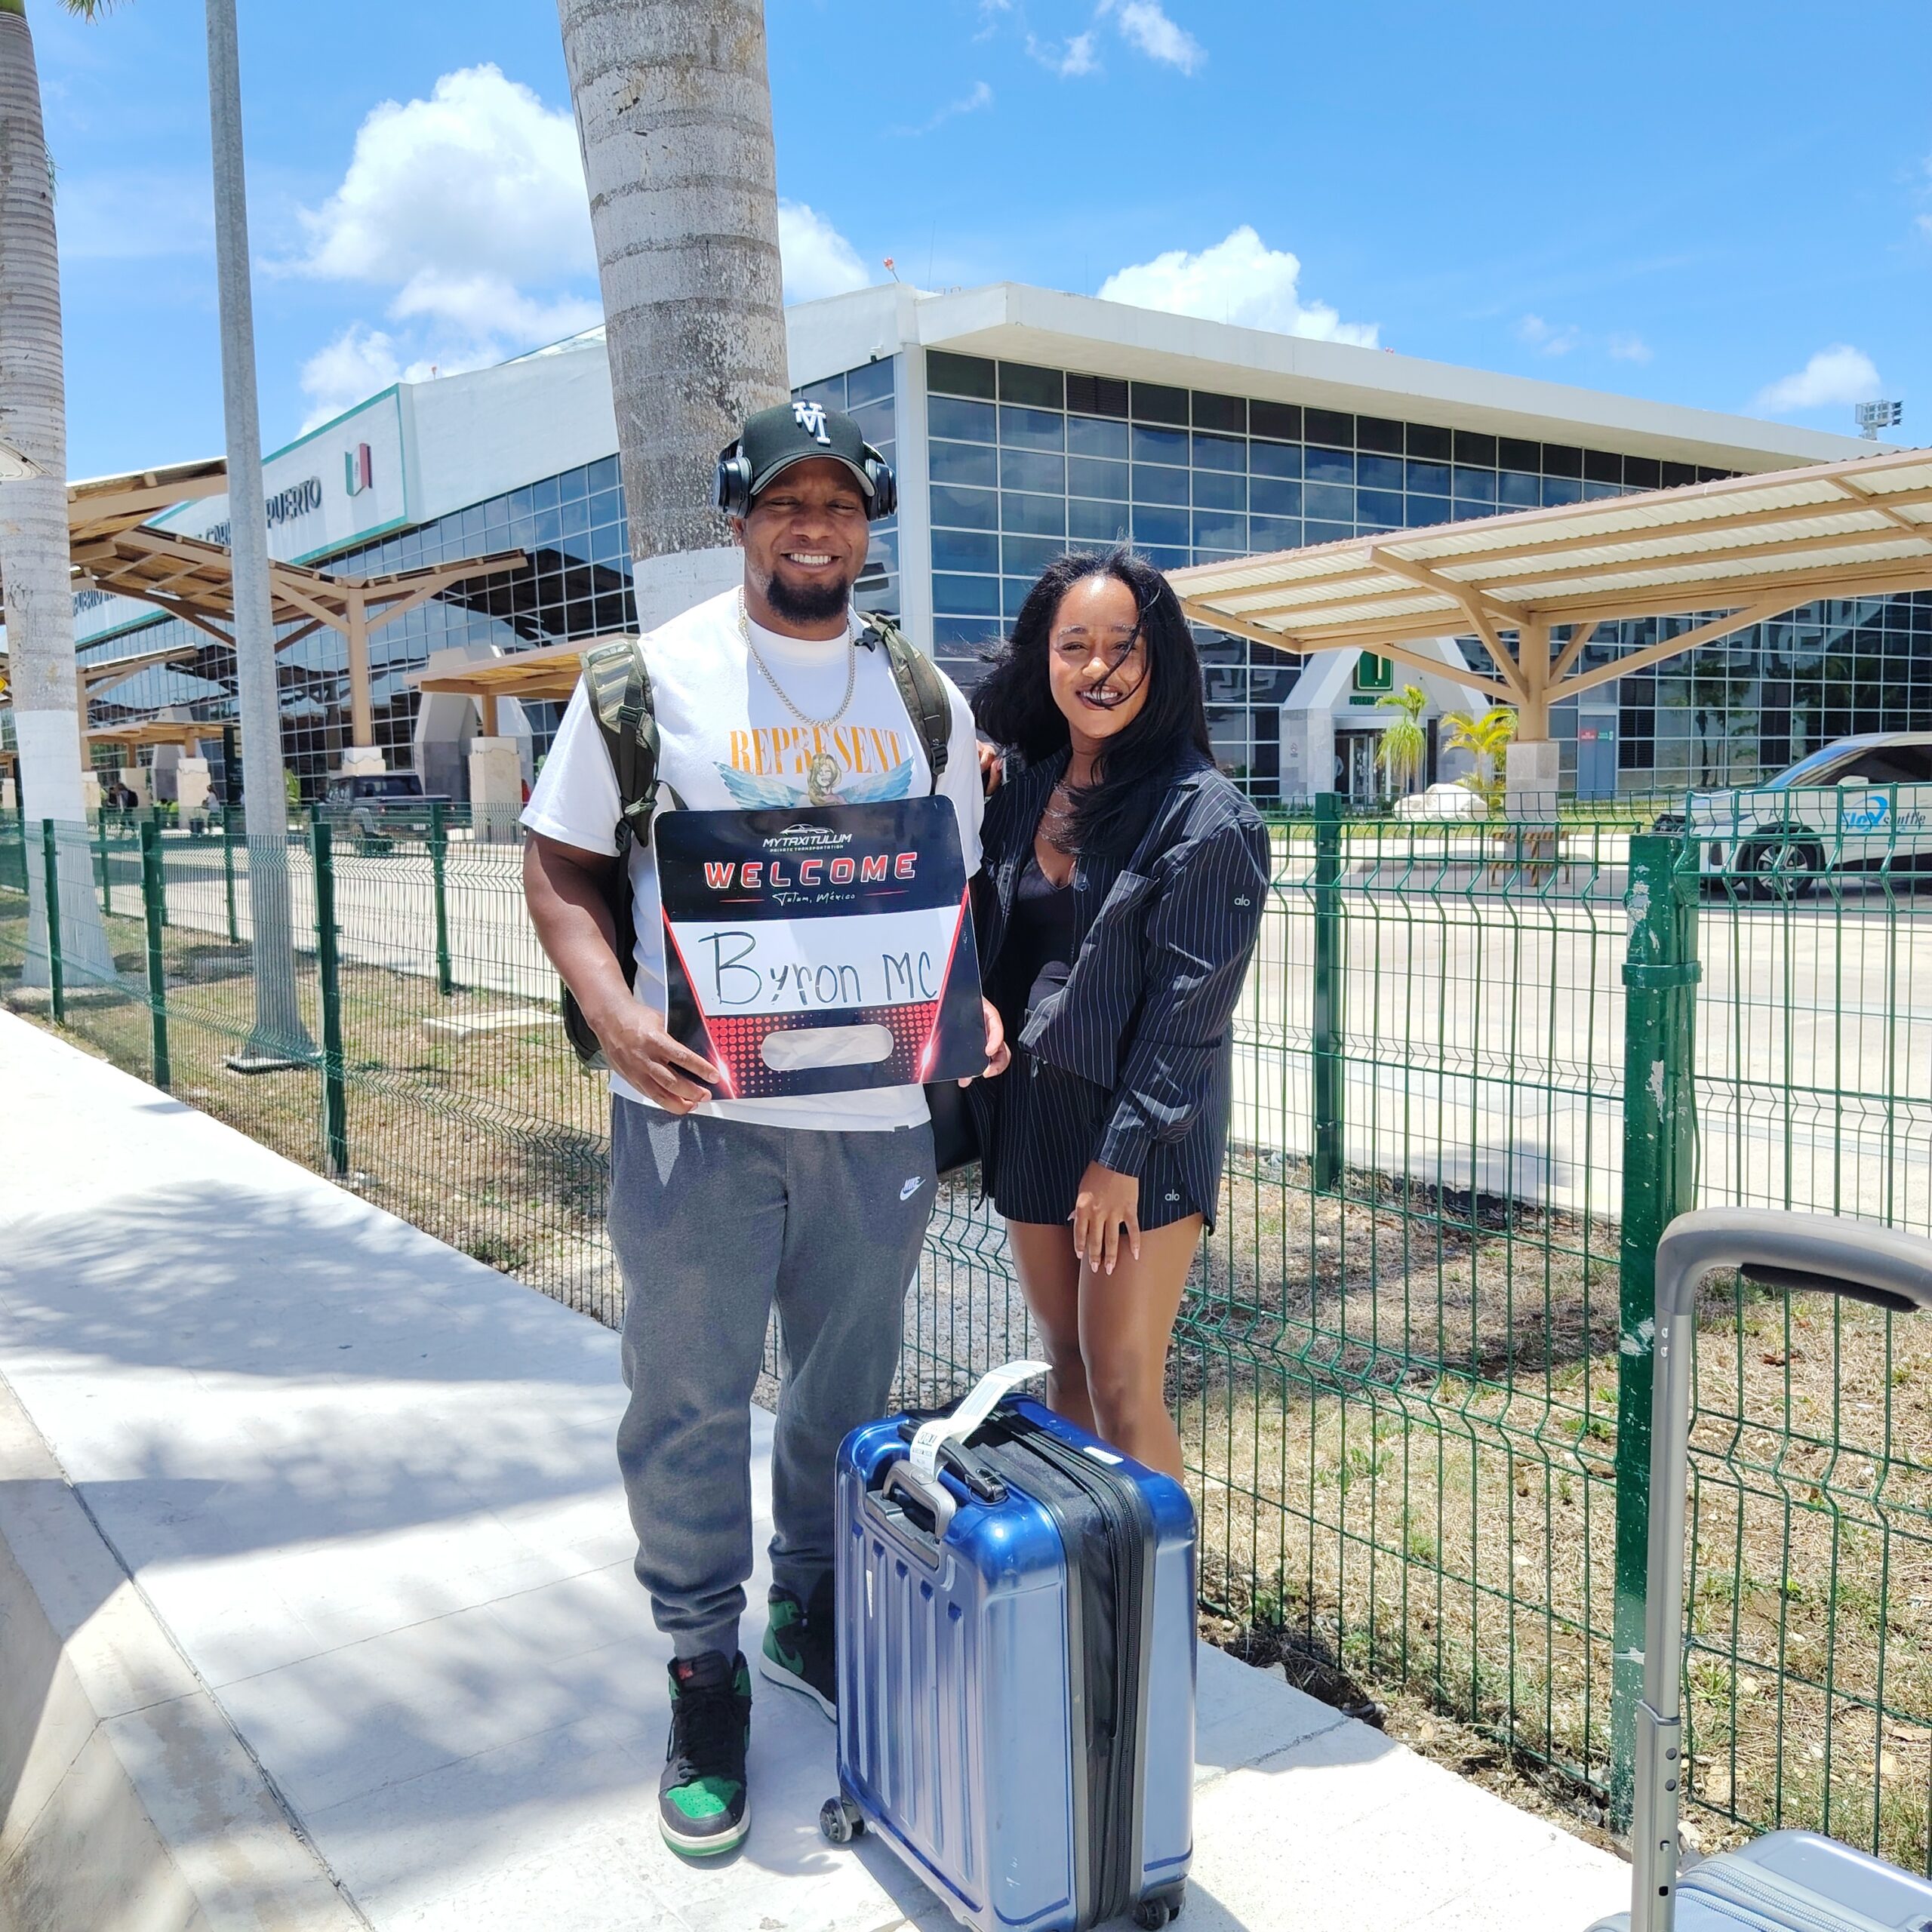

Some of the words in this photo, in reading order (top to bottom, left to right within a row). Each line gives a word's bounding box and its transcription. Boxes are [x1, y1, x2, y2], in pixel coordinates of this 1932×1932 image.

[266, 475, 321, 528] PUERTO
[730, 725, 902, 775] REPRESENT
[762, 833, 853, 848] MYTAXITULUM
[703, 852, 918, 888] WELCOME
[816, 891, 855, 904] México
[698, 931, 861, 1005] Byron
